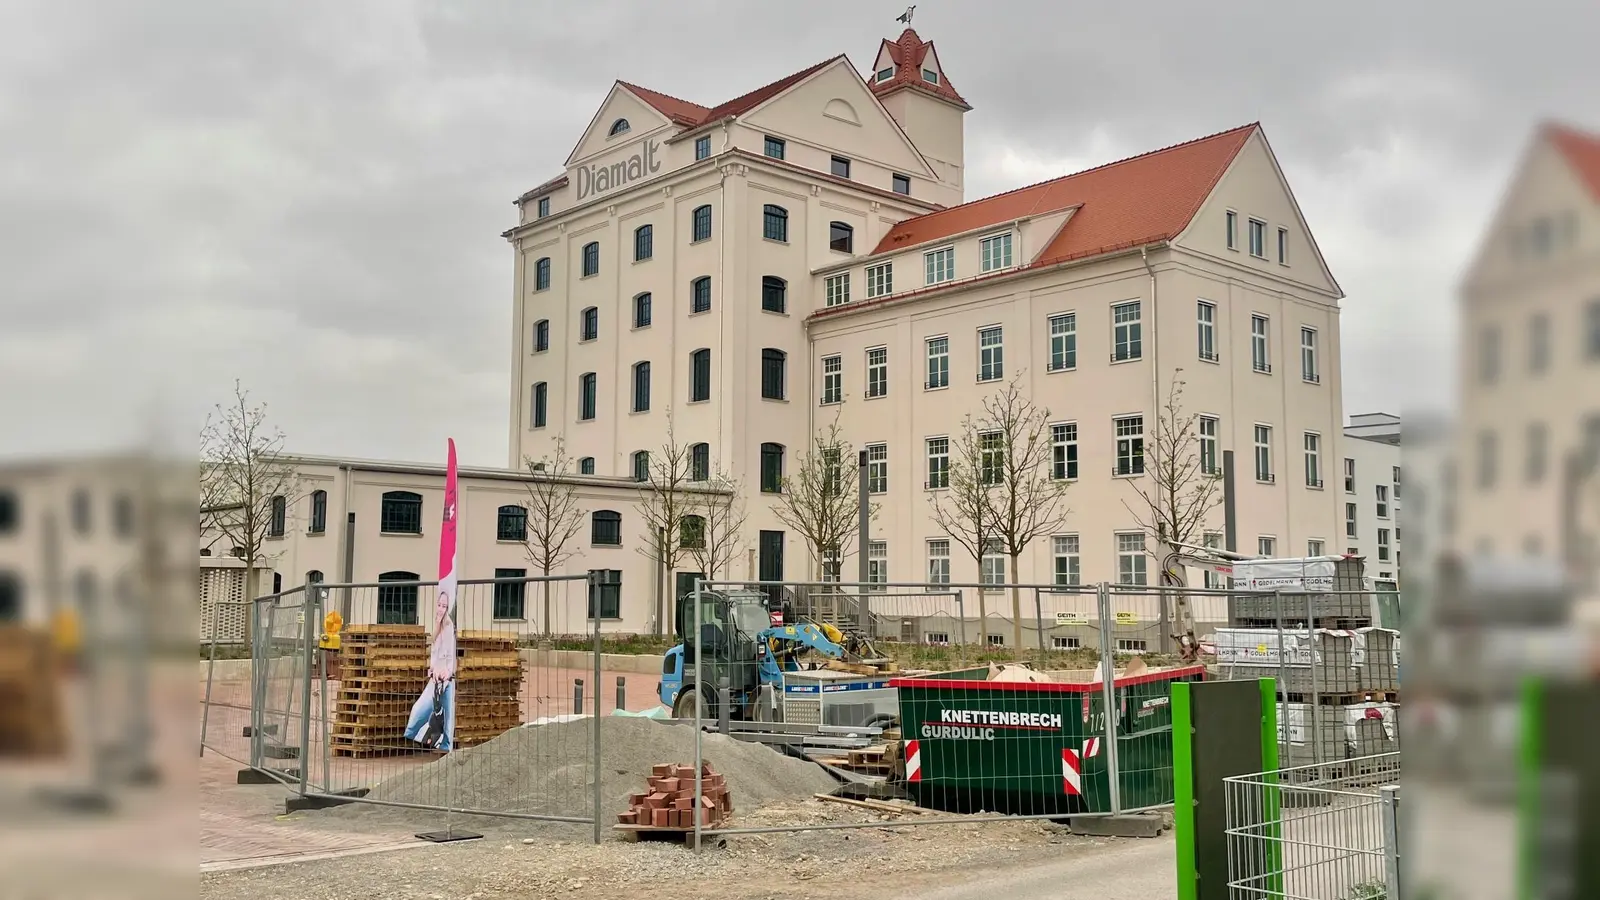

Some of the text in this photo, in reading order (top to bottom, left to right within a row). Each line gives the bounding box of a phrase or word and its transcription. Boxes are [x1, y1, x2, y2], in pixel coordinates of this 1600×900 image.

[576, 139, 661, 201] Diamalt
[941, 709, 1062, 728] KNETTENBRECH
[921, 725, 995, 741] GURDULIC
